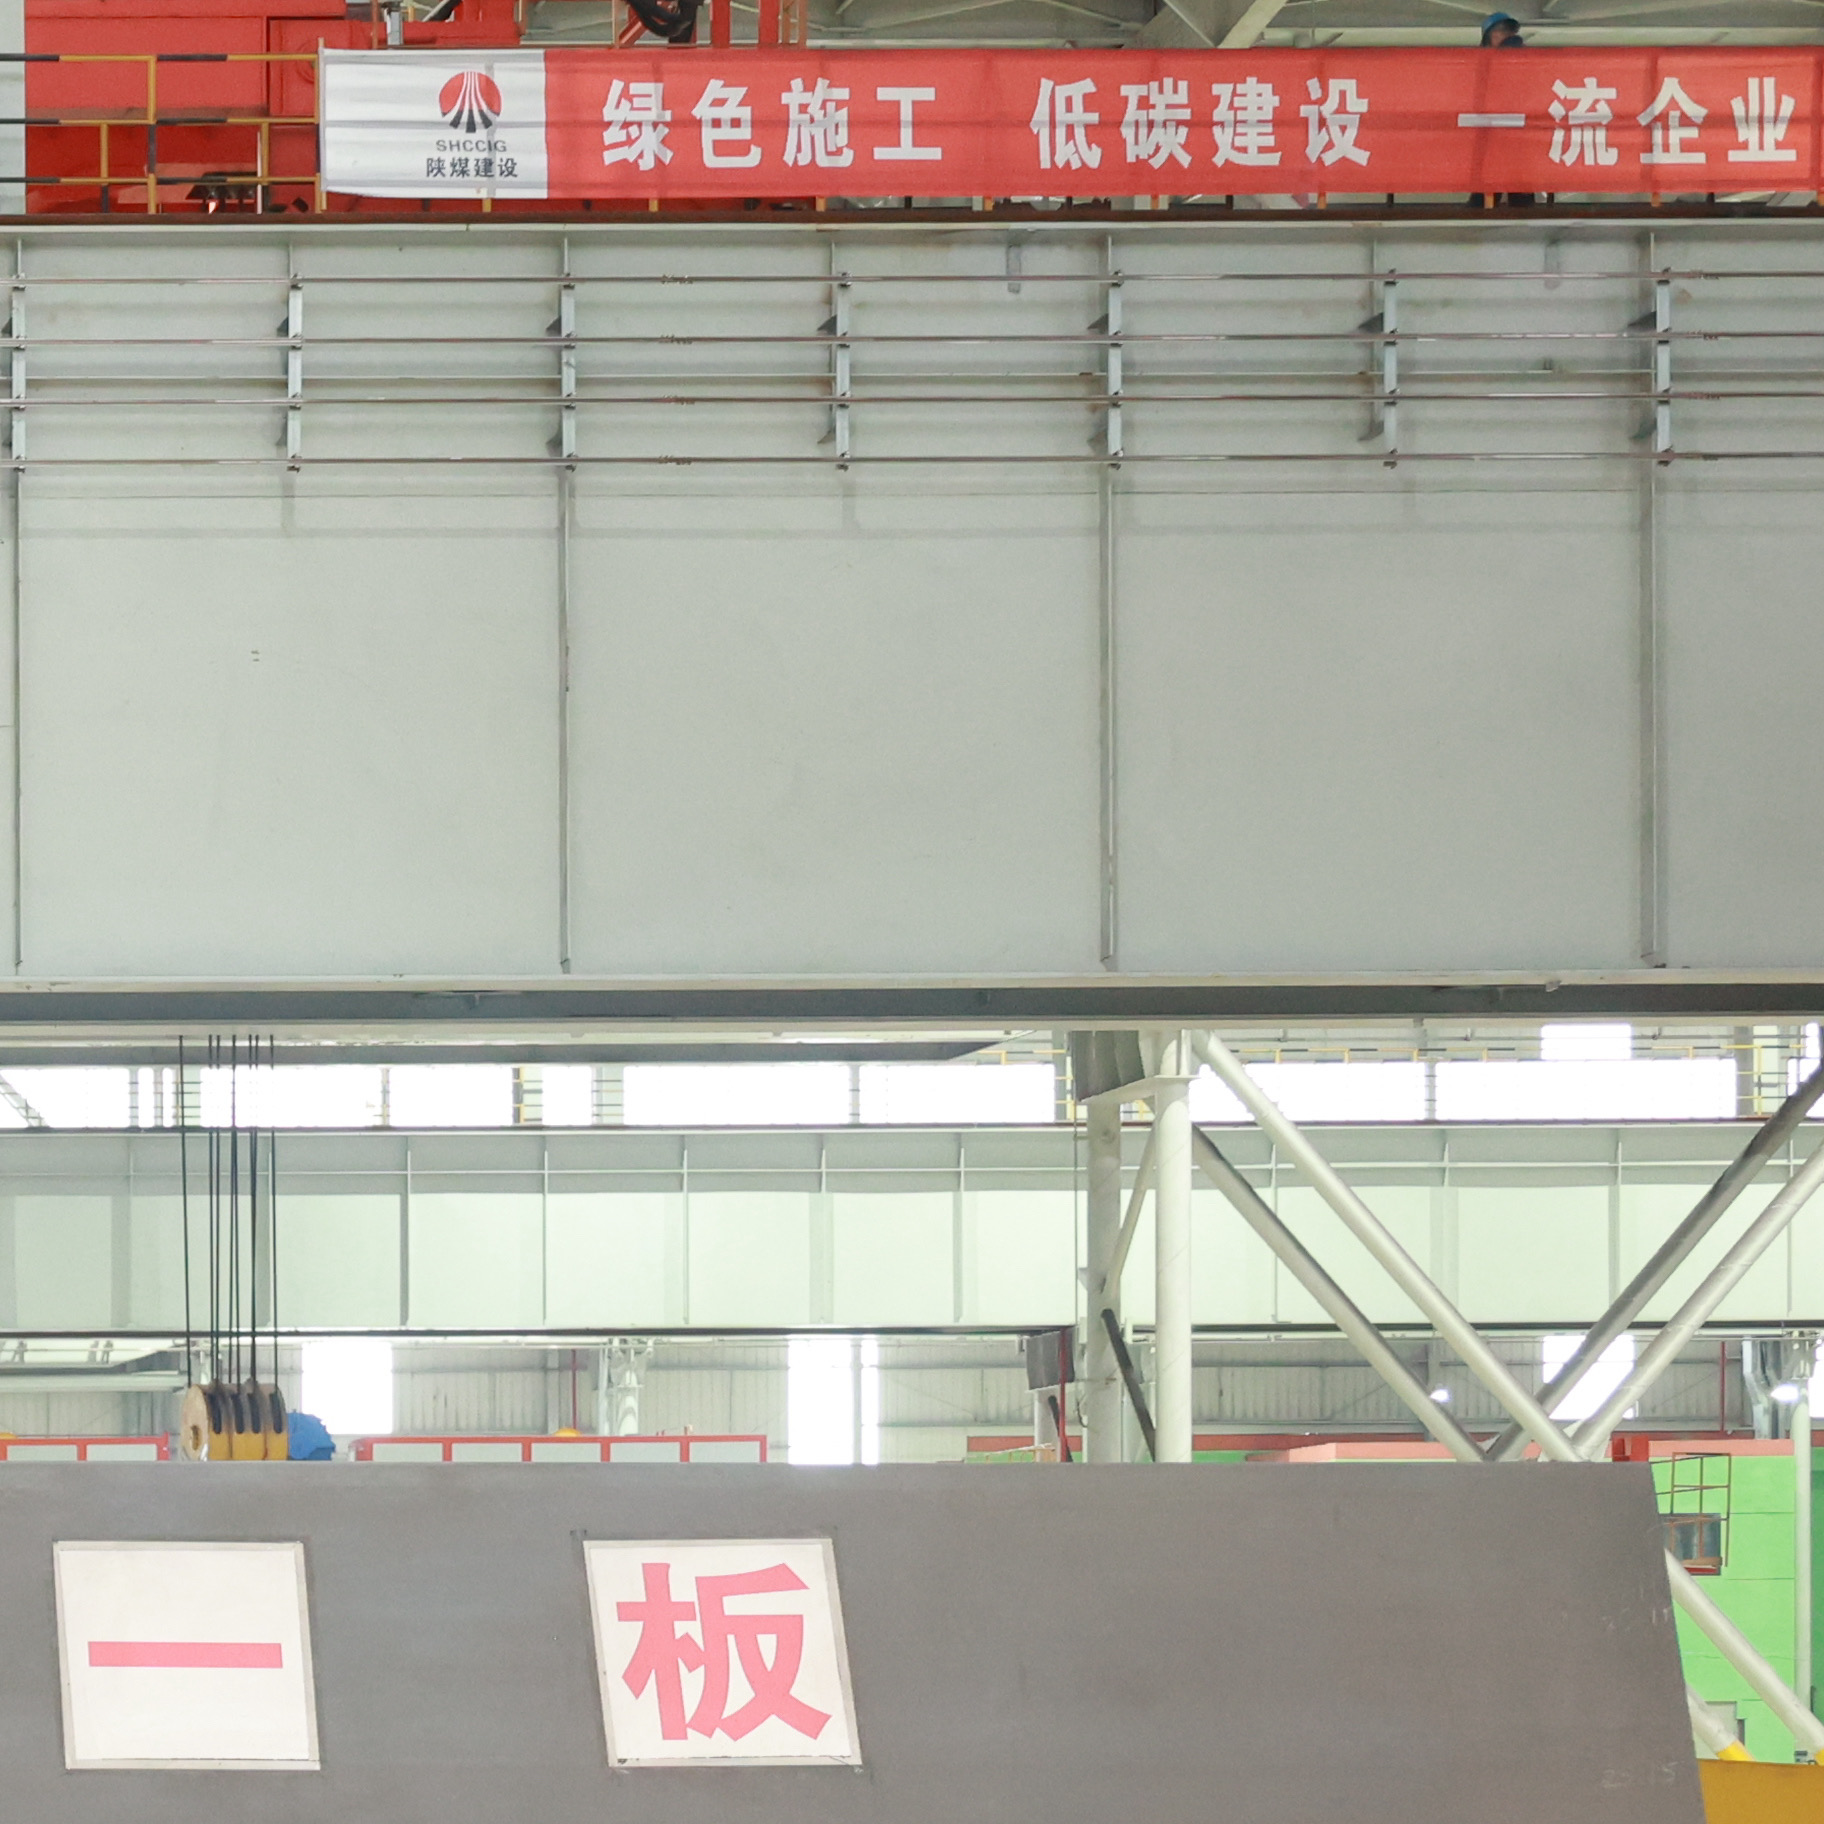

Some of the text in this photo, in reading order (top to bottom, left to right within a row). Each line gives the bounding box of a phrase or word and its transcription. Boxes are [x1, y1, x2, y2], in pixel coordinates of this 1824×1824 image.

[603, 76, 1798, 169] 绿色施工 低碳建设 一流企业
[435, 139, 508, 153] SHCCIG
[425, 156, 519, 179] 陕煤建设
